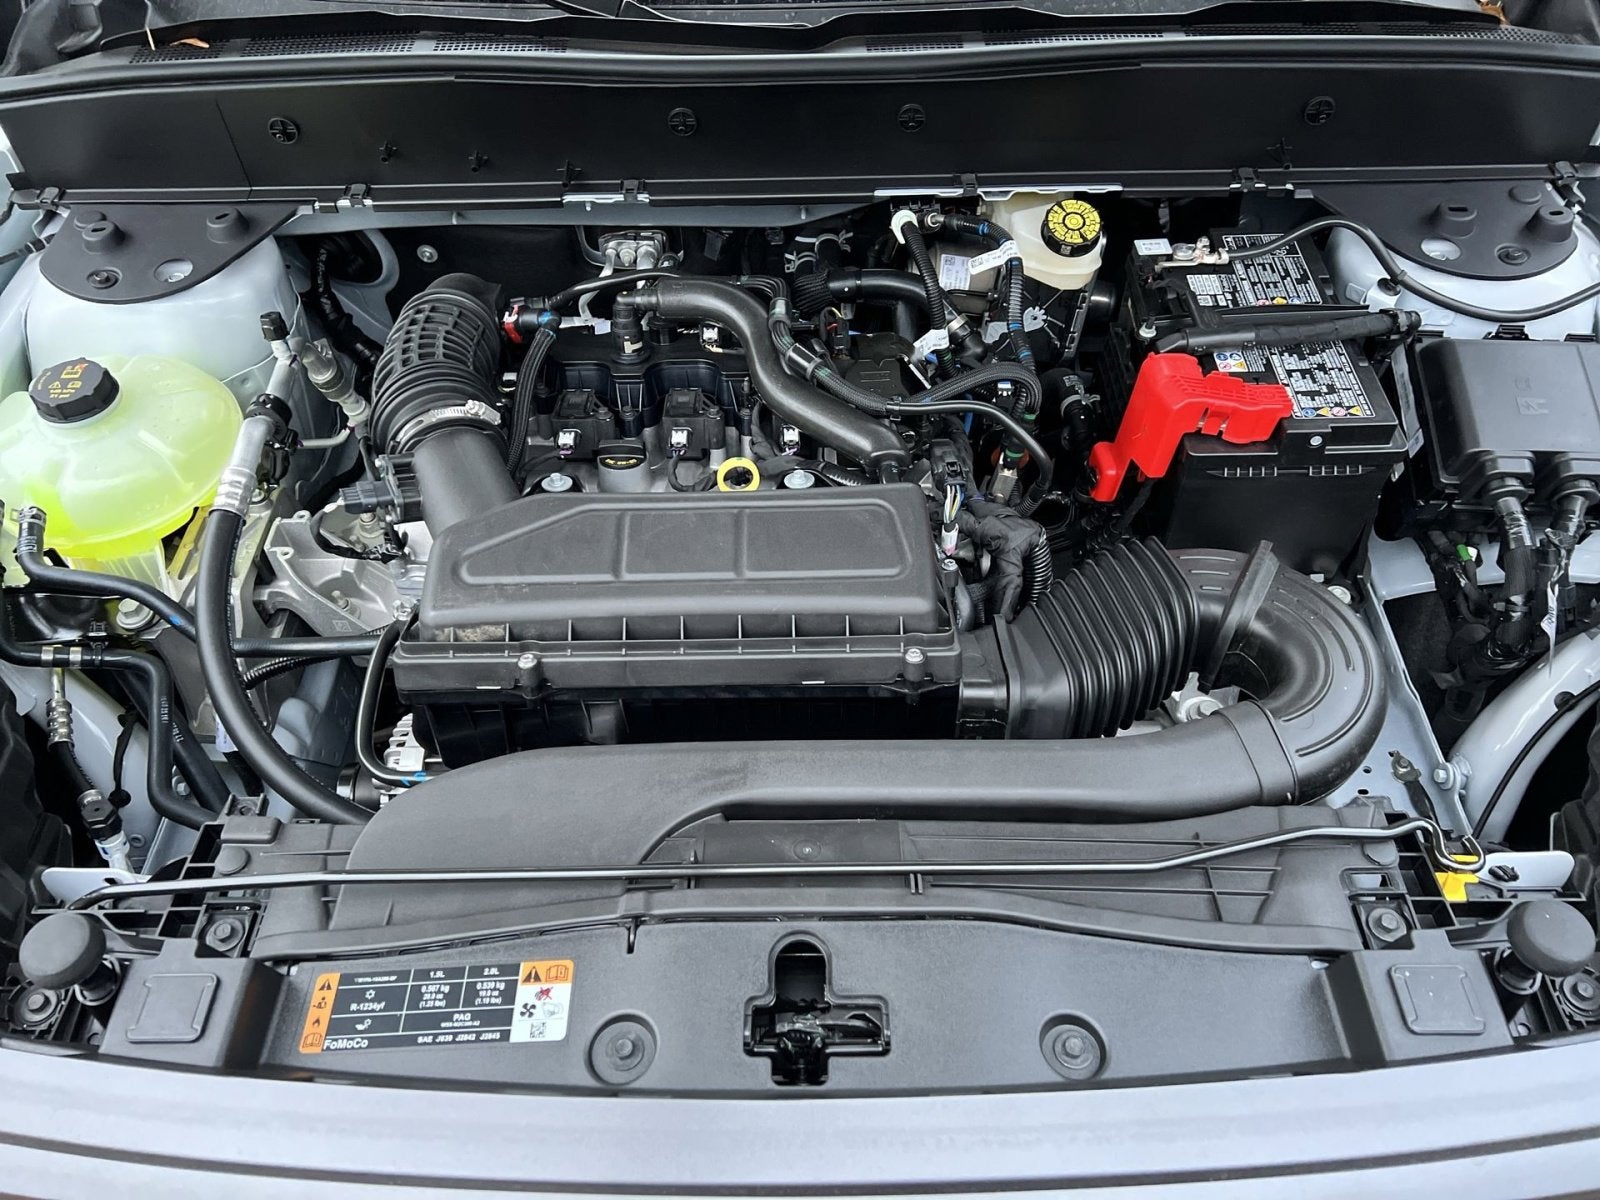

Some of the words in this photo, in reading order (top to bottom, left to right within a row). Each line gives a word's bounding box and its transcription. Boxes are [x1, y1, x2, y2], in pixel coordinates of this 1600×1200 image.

[429, 970, 446, 979] 1.5L
[483, 967, 500, 976] 2.0L
[440, 984, 450, 994] kg
[496, 981, 506, 991] kg
[350, 1001, 386, 1012] R-1234yf
[323, 1037, 369, 1051] FoMoCo
[417, 1035, 434, 1044] SAE
